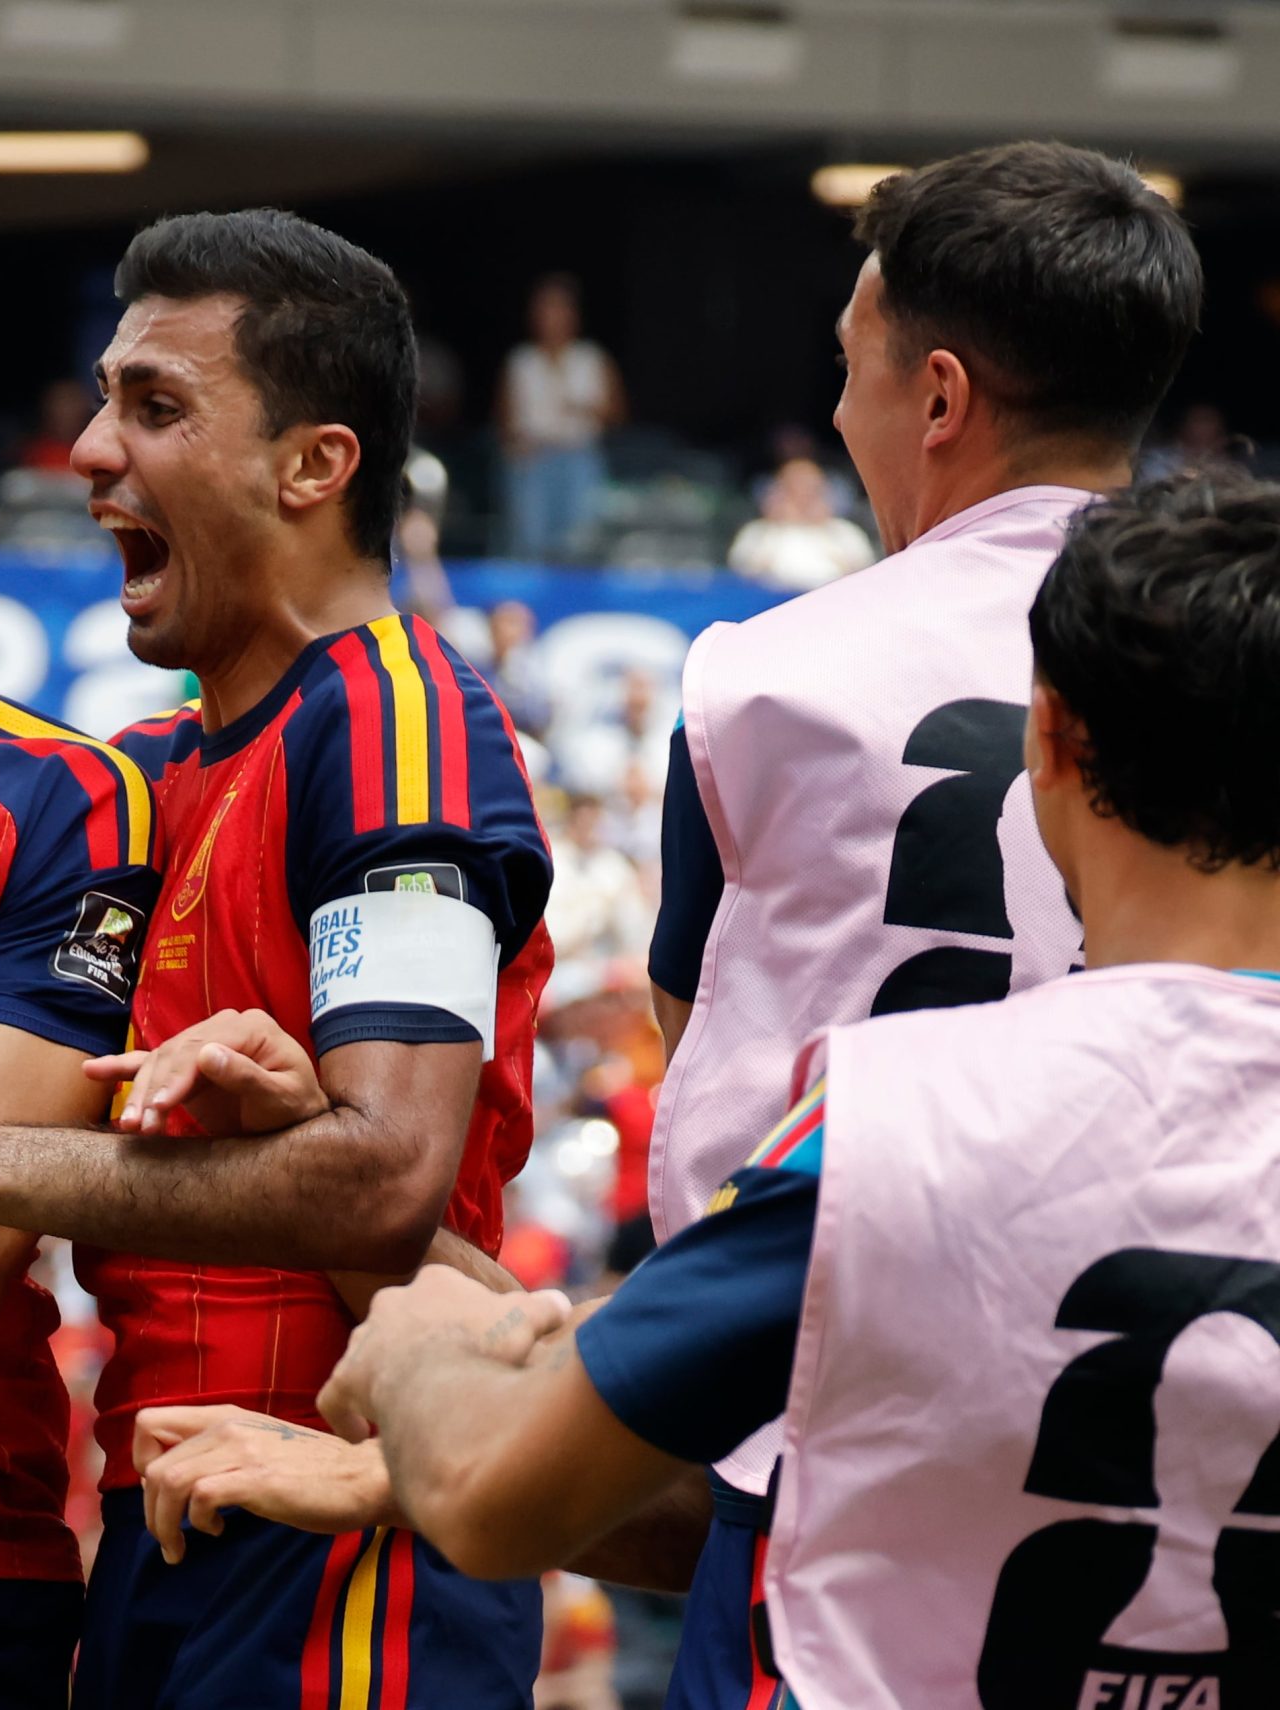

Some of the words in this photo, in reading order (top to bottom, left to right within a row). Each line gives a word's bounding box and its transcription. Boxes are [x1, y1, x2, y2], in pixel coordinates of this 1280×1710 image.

[311, 906, 363, 941] TBALL
[311, 928, 361, 968] ITES
[1076, 1669, 1220, 1710] FIFA
